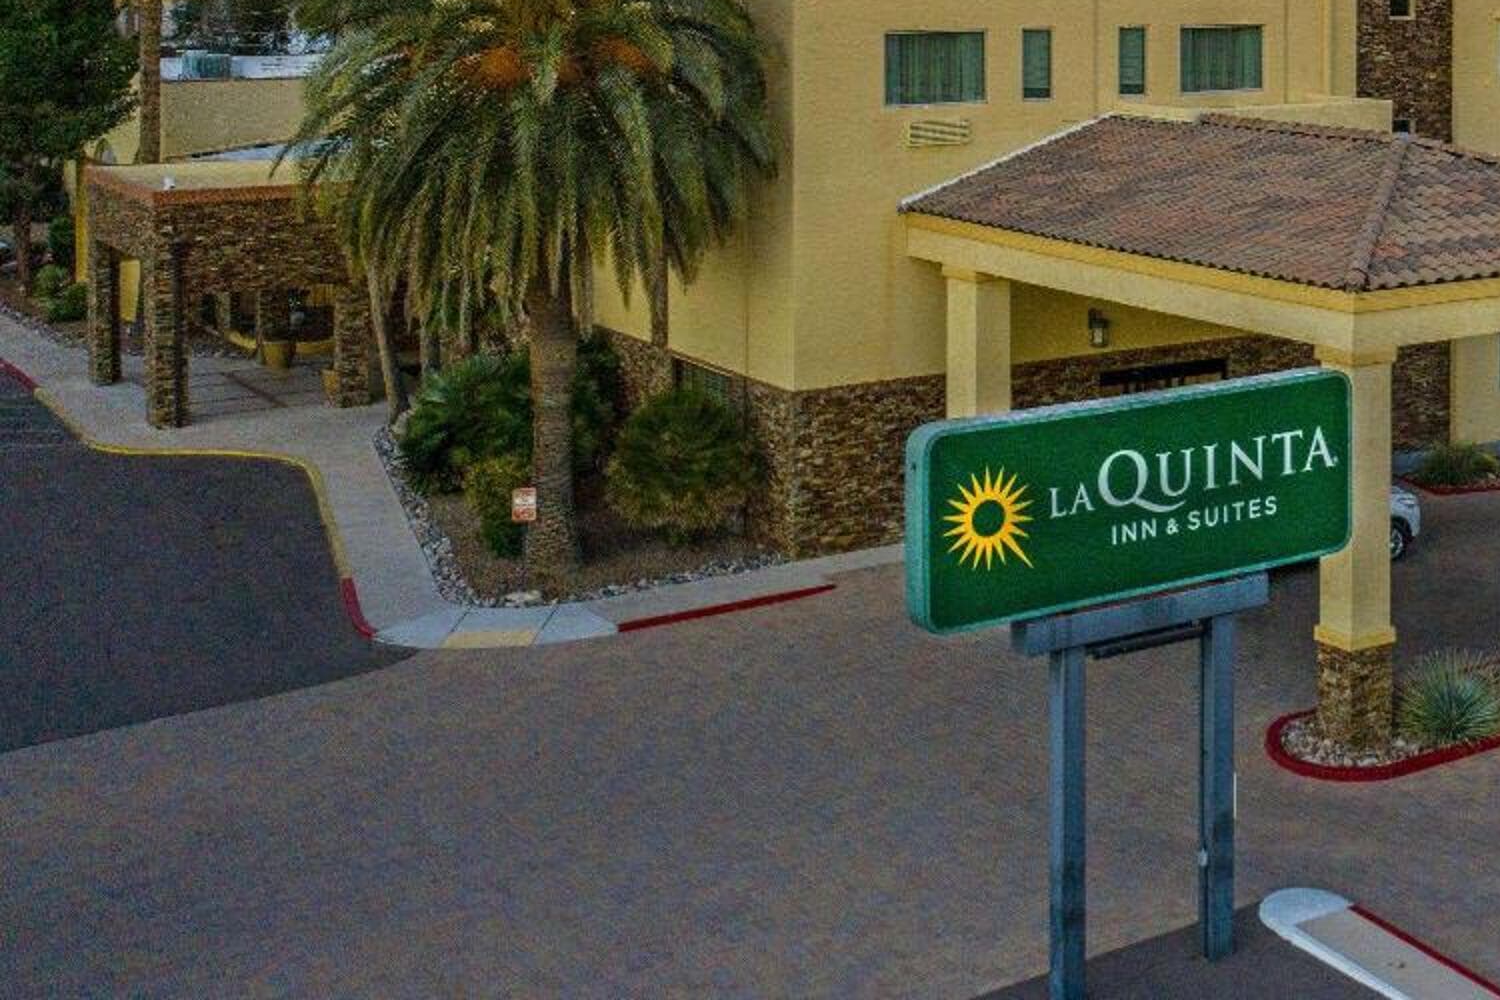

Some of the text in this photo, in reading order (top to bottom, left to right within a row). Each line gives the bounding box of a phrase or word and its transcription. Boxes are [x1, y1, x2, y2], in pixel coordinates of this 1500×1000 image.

[1049, 425, 1336, 519] LA QUINTA
[1111, 495, 1278, 545] INN & SUITES
